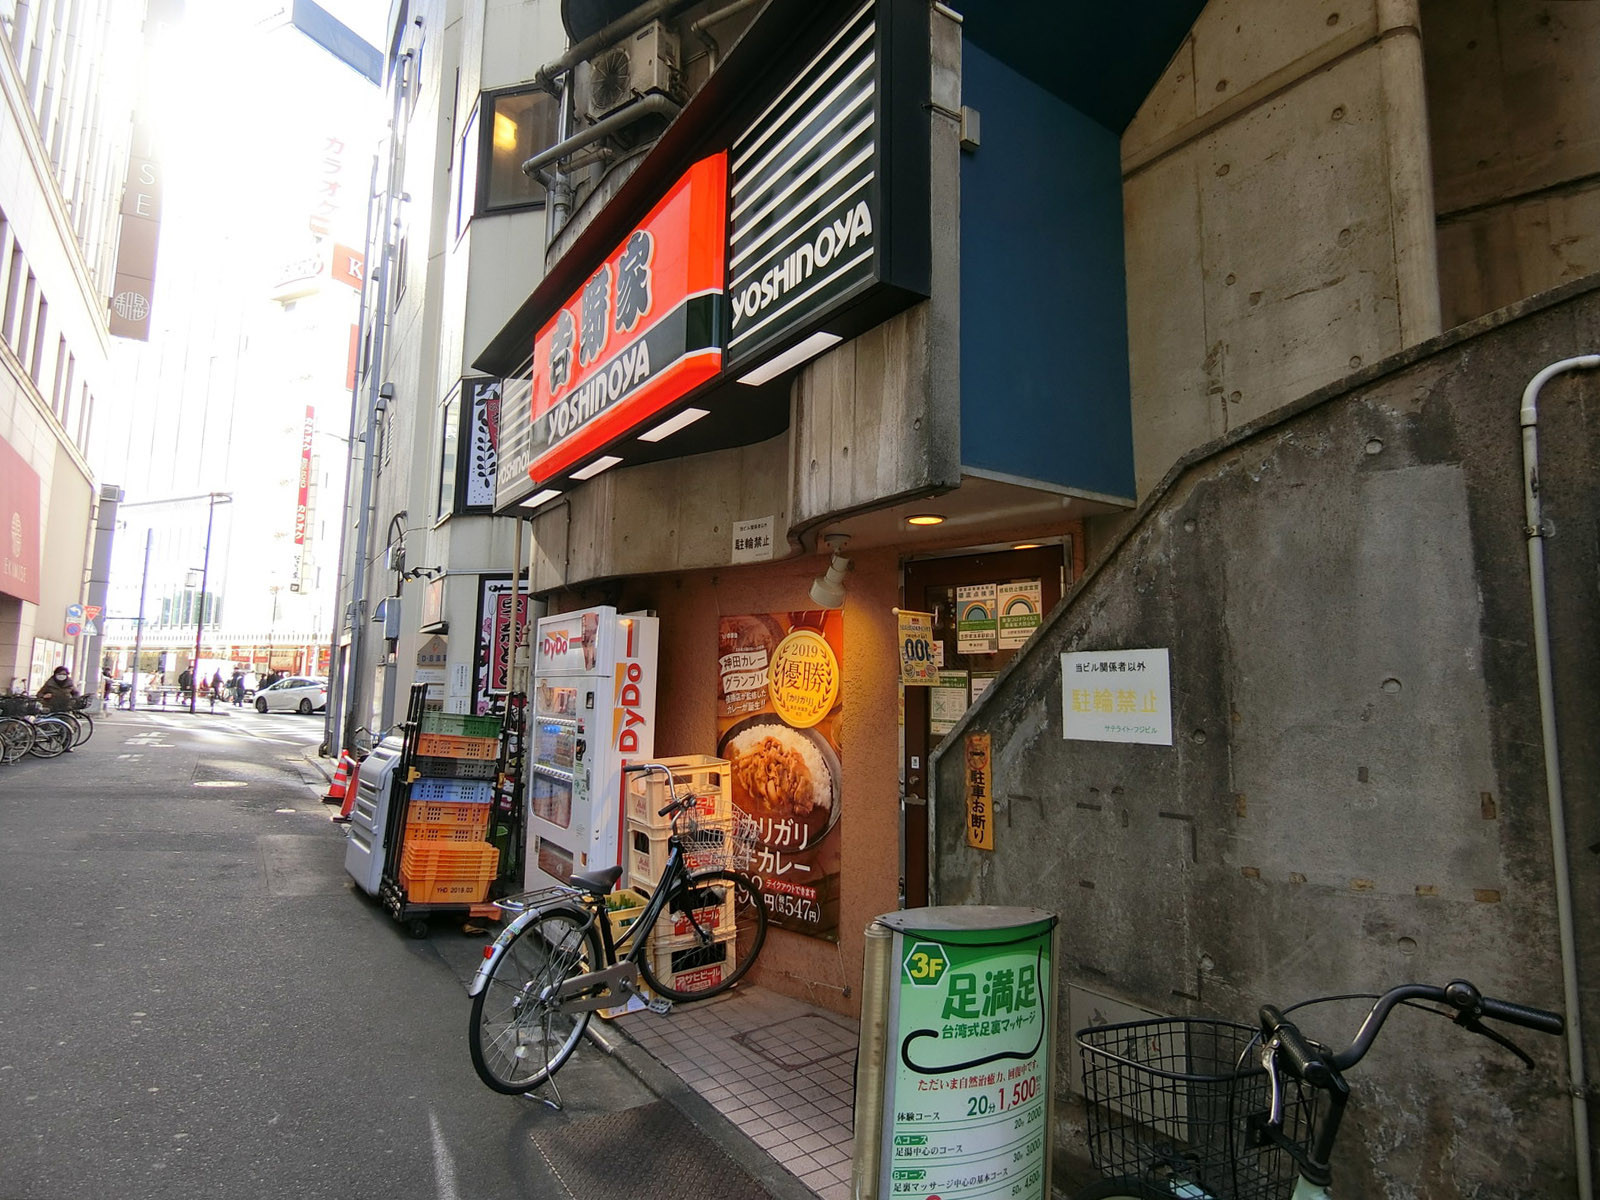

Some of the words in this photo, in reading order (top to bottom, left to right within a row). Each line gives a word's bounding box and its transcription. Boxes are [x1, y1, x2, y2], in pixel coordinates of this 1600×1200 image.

[731, 200, 873, 330] YOSHINOYA
[549, 229, 655, 396] 吉野家
[548, 339, 650, 446] YOSHINOYA
[735, 535, 770, 551] 駐輪禁止
[543, 637, 568, 660] DyDo
[791, 643, 818, 658] 2019
[723, 654, 766, 671] 神田カレー
[1075, 661, 1147, 673] 当ビル関係者以外
[725, 672, 764, 690] グランプリ
[780, 658, 825, 694] 優勝
[619, 662, 646, 752] DyDo
[1071, 687, 1159, 713] 駐輪禁止
[970, 770, 986, 844] 駐車お断り
[766, 879, 816, 898] テイクアウトできます
[676, 967, 722, 986] アサヒビール
[910, 952, 944, 978] 3F
[941, 964, 1037, 1020] 足満足
[942, 1010, 1036, 1040] 台湾式足裏マッサージ
[897, 1111, 941, 1122] 体験コース
[966, 1095, 996, 1117] 20分
[895, 1135, 927, 1145] Aコース
[895, 1144, 963, 1157] 足湯中心のコース
[893, 1170, 927, 1180] Bコース
[893, 1168, 1009, 1192] 足裏マッサージ中心の基本コース
